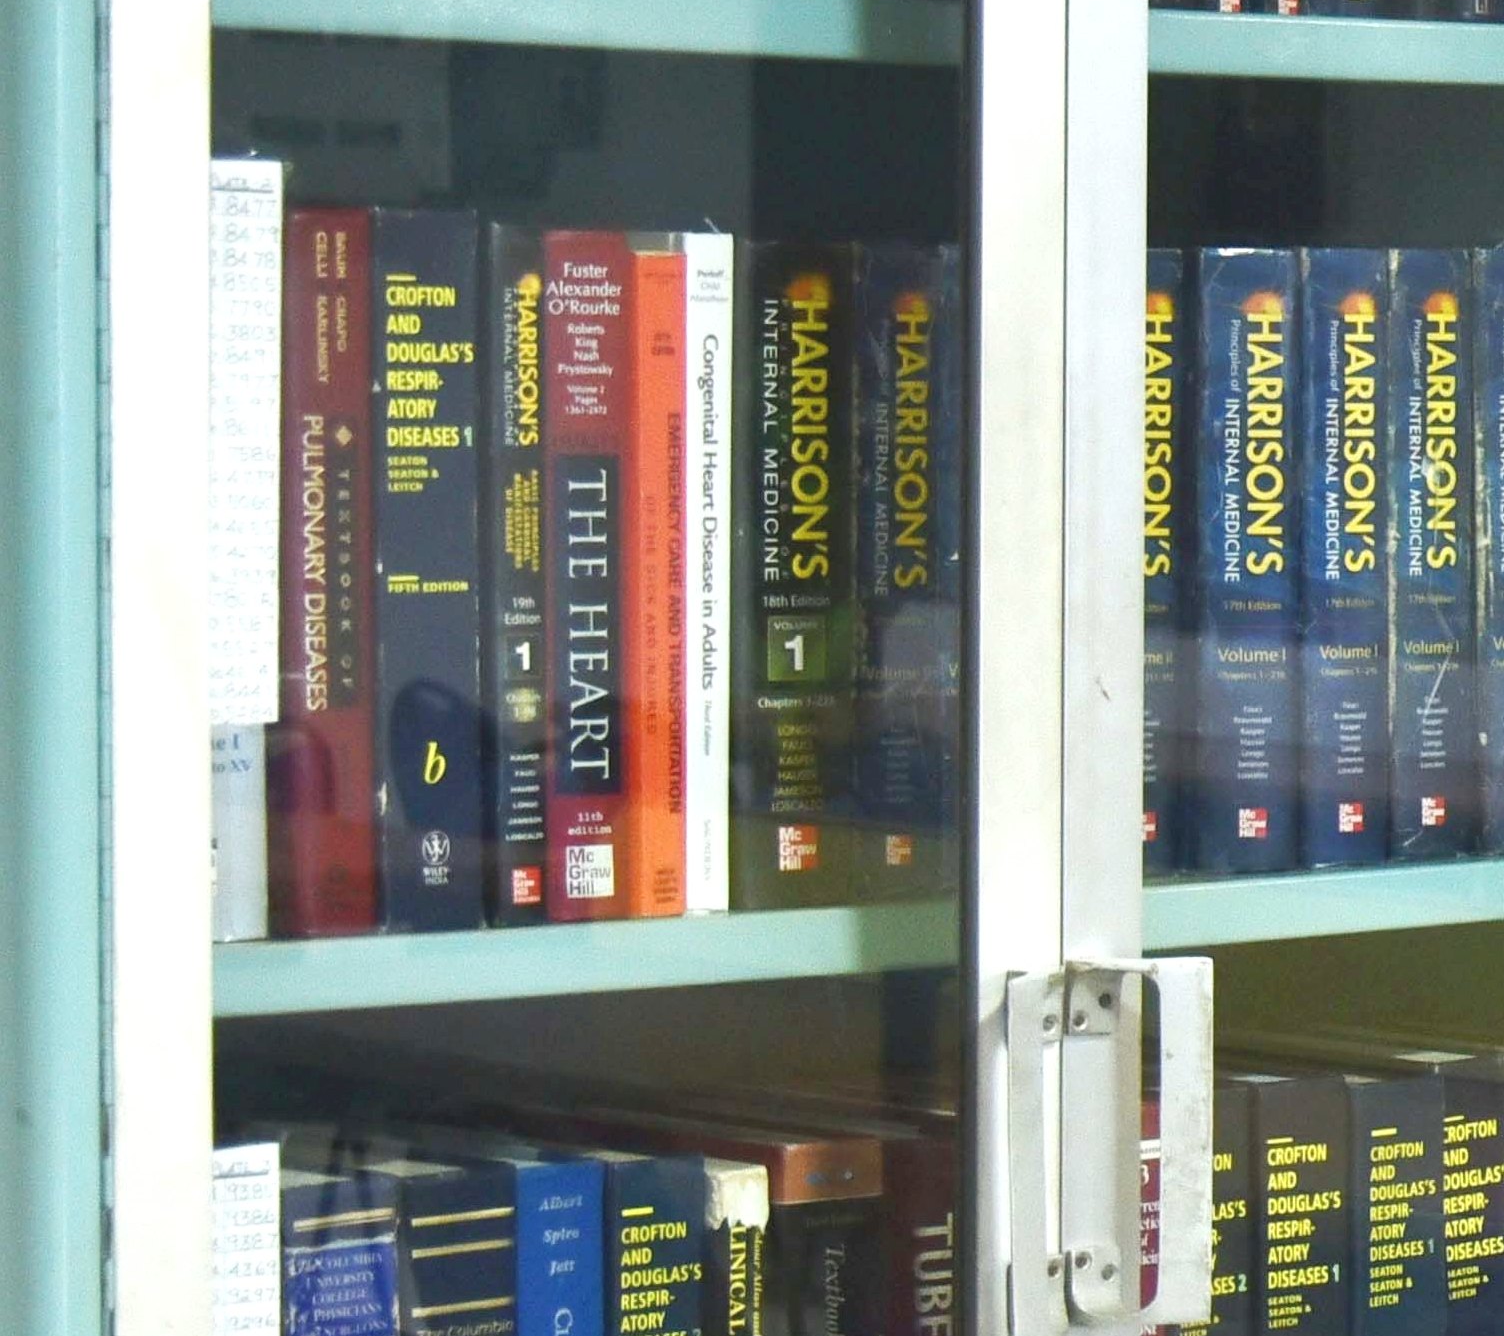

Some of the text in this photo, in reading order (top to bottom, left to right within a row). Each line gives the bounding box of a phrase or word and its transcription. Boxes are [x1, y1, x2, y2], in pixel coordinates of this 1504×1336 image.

[386, 283, 456, 308] CROFTON
[546, 278, 622, 299] Alexander
[563, 261, 609, 281] Fuster
[386, 314, 422, 336] AND
[548, 297, 621, 317] O'Rourke
[386, 341, 474, 364] DOUGLAS'S
[386, 370, 444, 391] RESPIR-
[517, 285, 540, 448] HARRISON'S
[386, 398, 437, 420] ATORY
[697, 332, 719, 444] Congenital
[386, 425, 460, 448] DISEASES
[763, 298, 779, 582] INTERNAL MEDICINE
[792, 300, 829, 580] HARRISON'S
[894, 309, 928, 589] HARRISON'S
[1145, 314, 1173, 578] HARRISON'S
[1247, 313, 1285, 575] HARRISON'S
[1343, 313, 1376, 574] HARRISON'S
[1425, 312, 1457, 570] HARRISON'S
[701, 451, 717, 507] Heart
[1224, 398, 1241, 583] INTERNAL MEDICINE
[302, 414, 327, 712] PULMONARY DISEASES
[701, 512, 717, 591] Disease
[567, 468, 610, 781] THE HEART
[702, 622, 717, 692] Adults
[621, 1221, 688, 1246] CROFTON
[621, 1246, 653, 1268] AND
[620, 1263, 702, 1290] DOUGLAS'S
[620, 1291, 677, 1313] RESPIR-
[728, 1222, 747, 1333] LINICAL
[620, 1312, 666, 1333] ATORY
